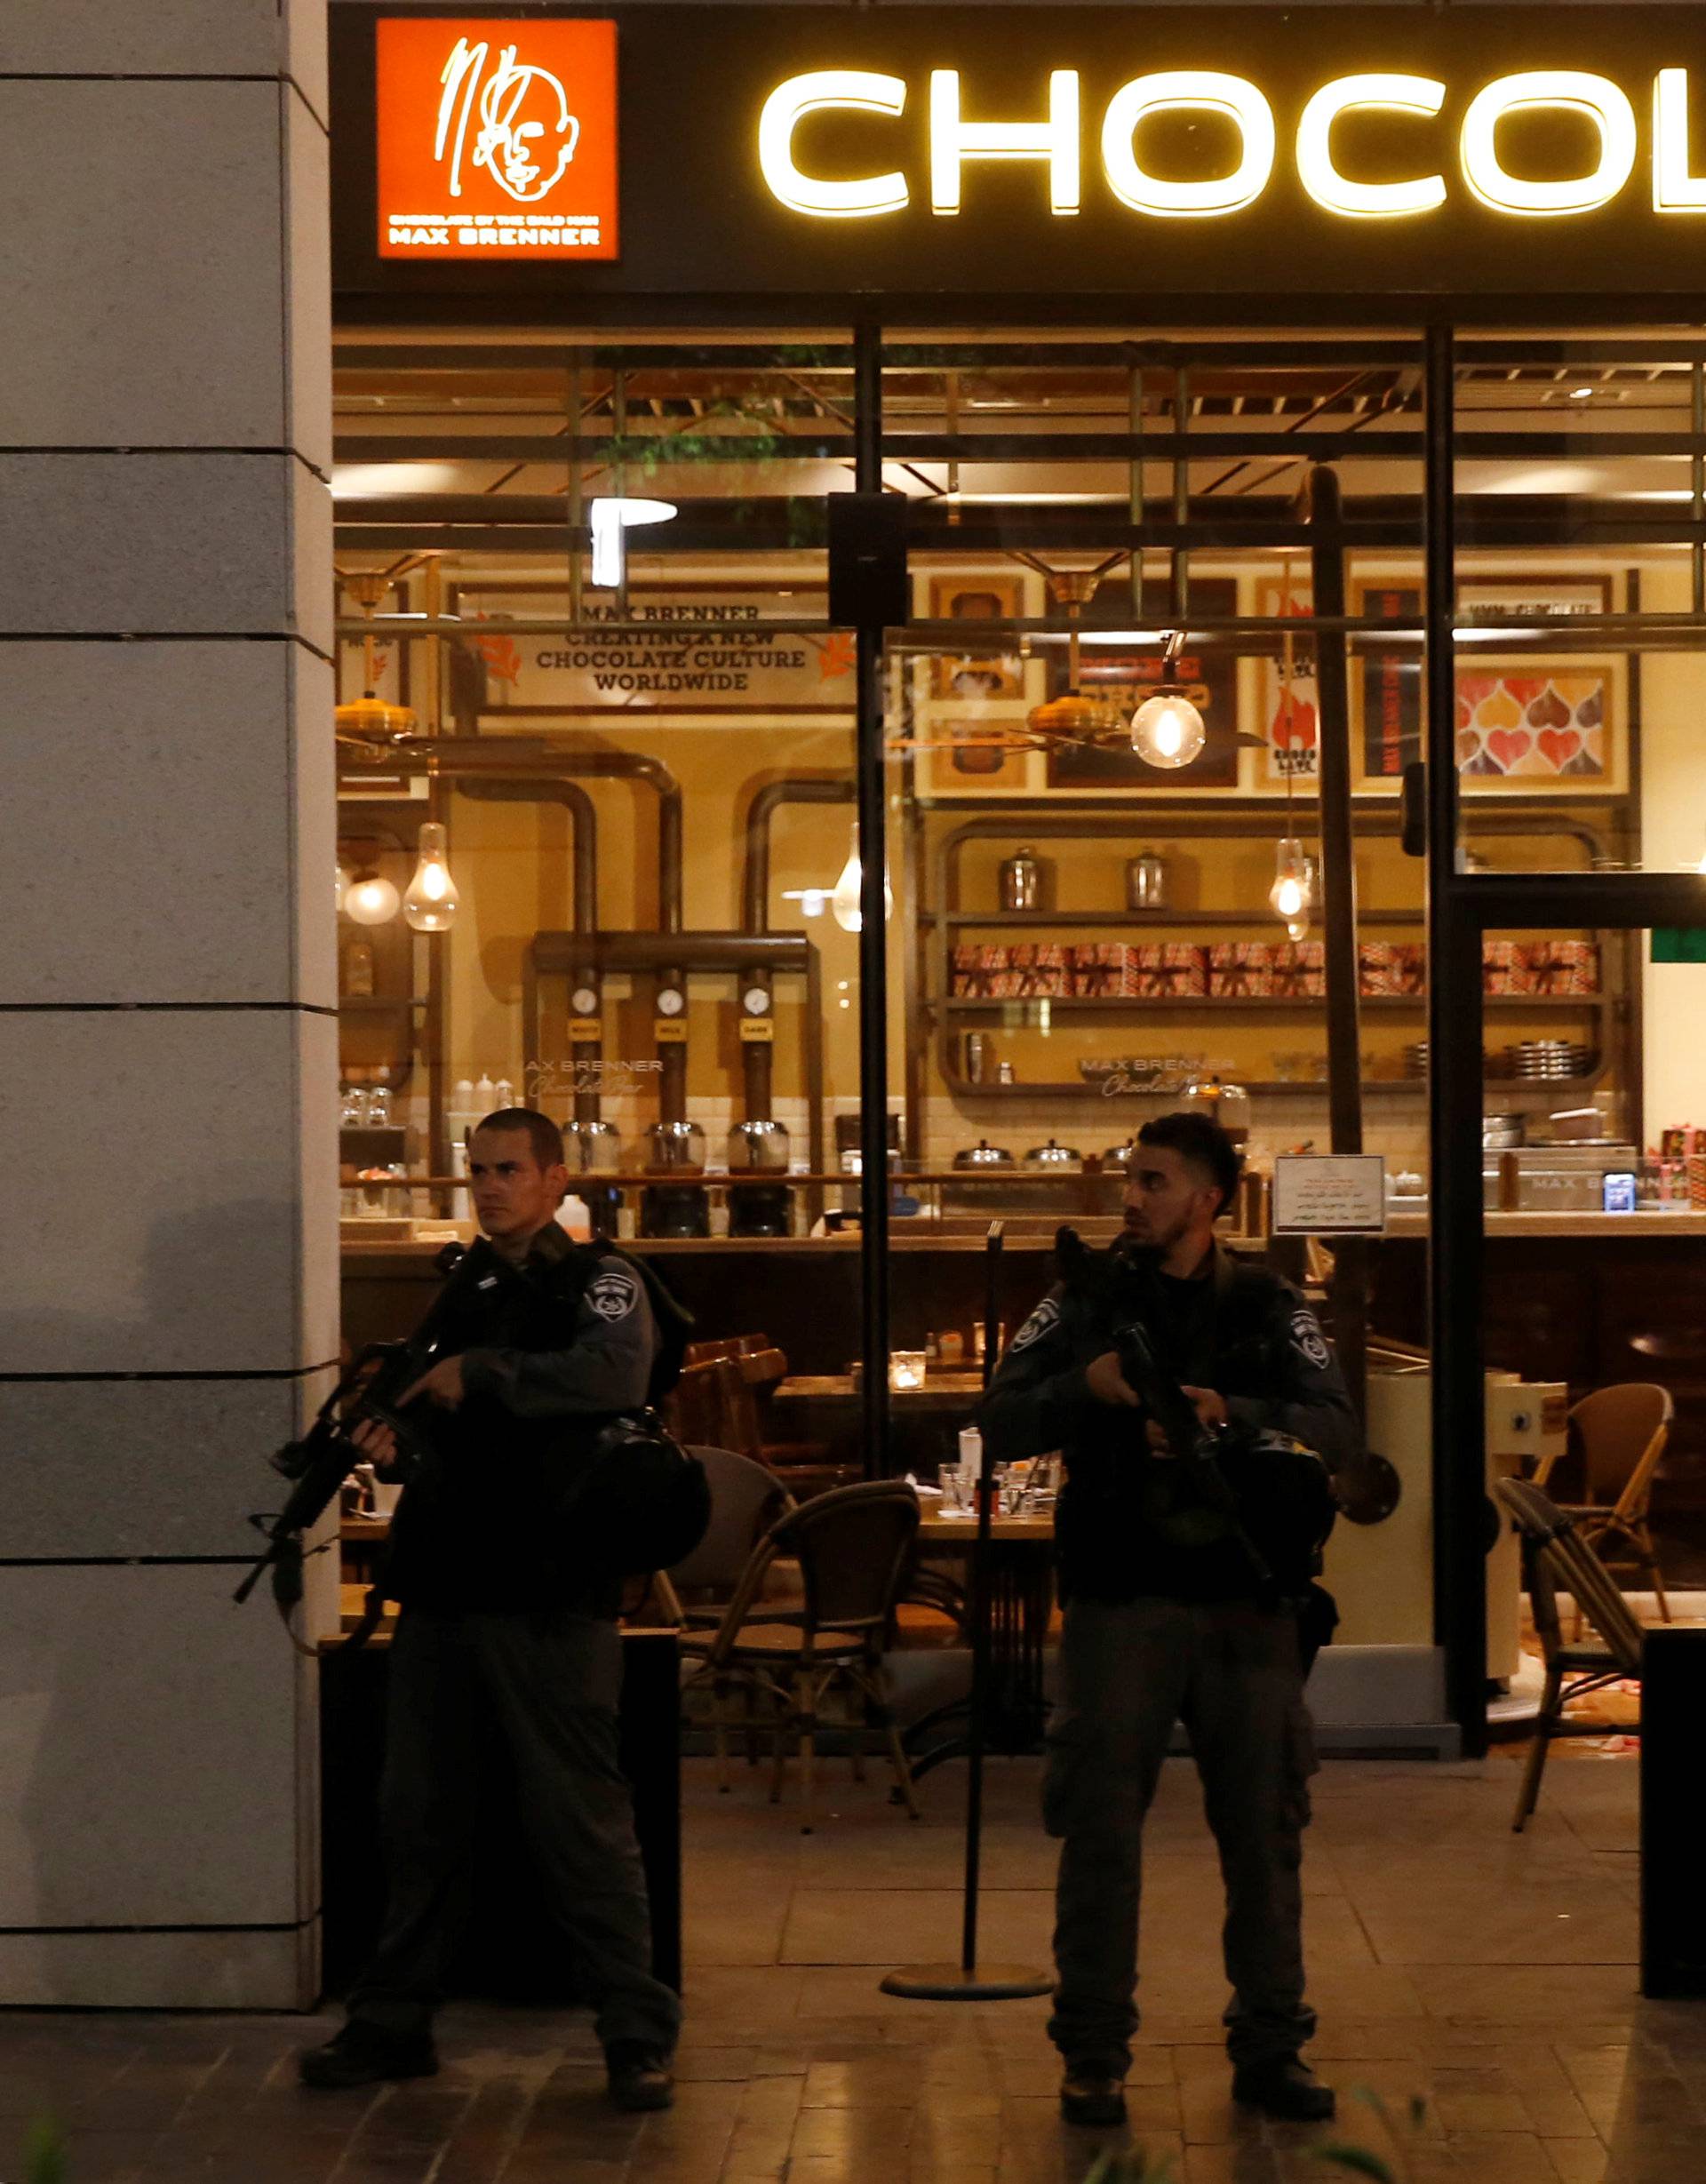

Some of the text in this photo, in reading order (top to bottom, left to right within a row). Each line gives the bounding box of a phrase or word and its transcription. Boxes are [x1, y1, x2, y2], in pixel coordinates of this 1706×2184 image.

[759, 68, 1706, 217] CHOCOL
[389, 228, 600, 245] MAX BRENNER
[645, 606, 759, 621] BRENNER
[721, 631, 775, 646] NEW
[536, 650, 805, 668] CHOCOLATE CULTURE
[594, 674, 748, 691] WORLDWIDE
[561, 1060, 665, 1072] BRENNER
[1080, 1059, 1236, 1072] MAX BRENNER
[1532, 1177, 1576, 1189] MAX
